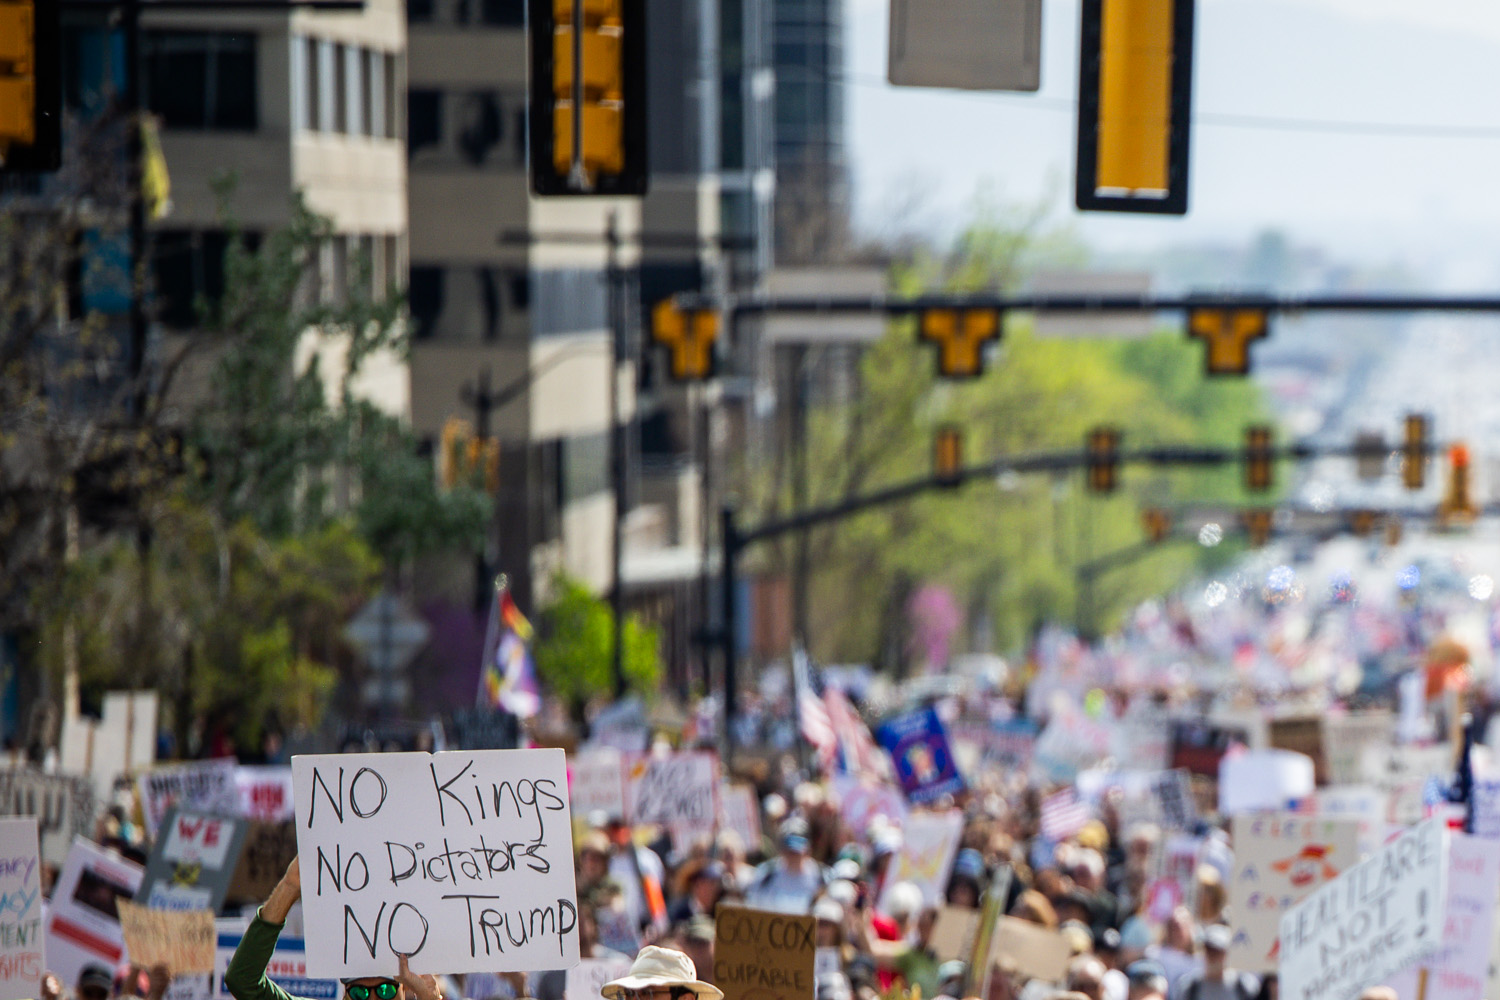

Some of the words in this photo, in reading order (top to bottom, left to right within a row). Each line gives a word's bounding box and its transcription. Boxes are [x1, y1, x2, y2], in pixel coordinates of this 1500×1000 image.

[307, 766, 388, 829] NO
[430, 760, 565, 841] Kings
[384, 834, 551, 887] Dictators
[344, 902, 429, 965] NO
[715, 910, 763, 945] GOV
[768, 917, 815, 952] COX
